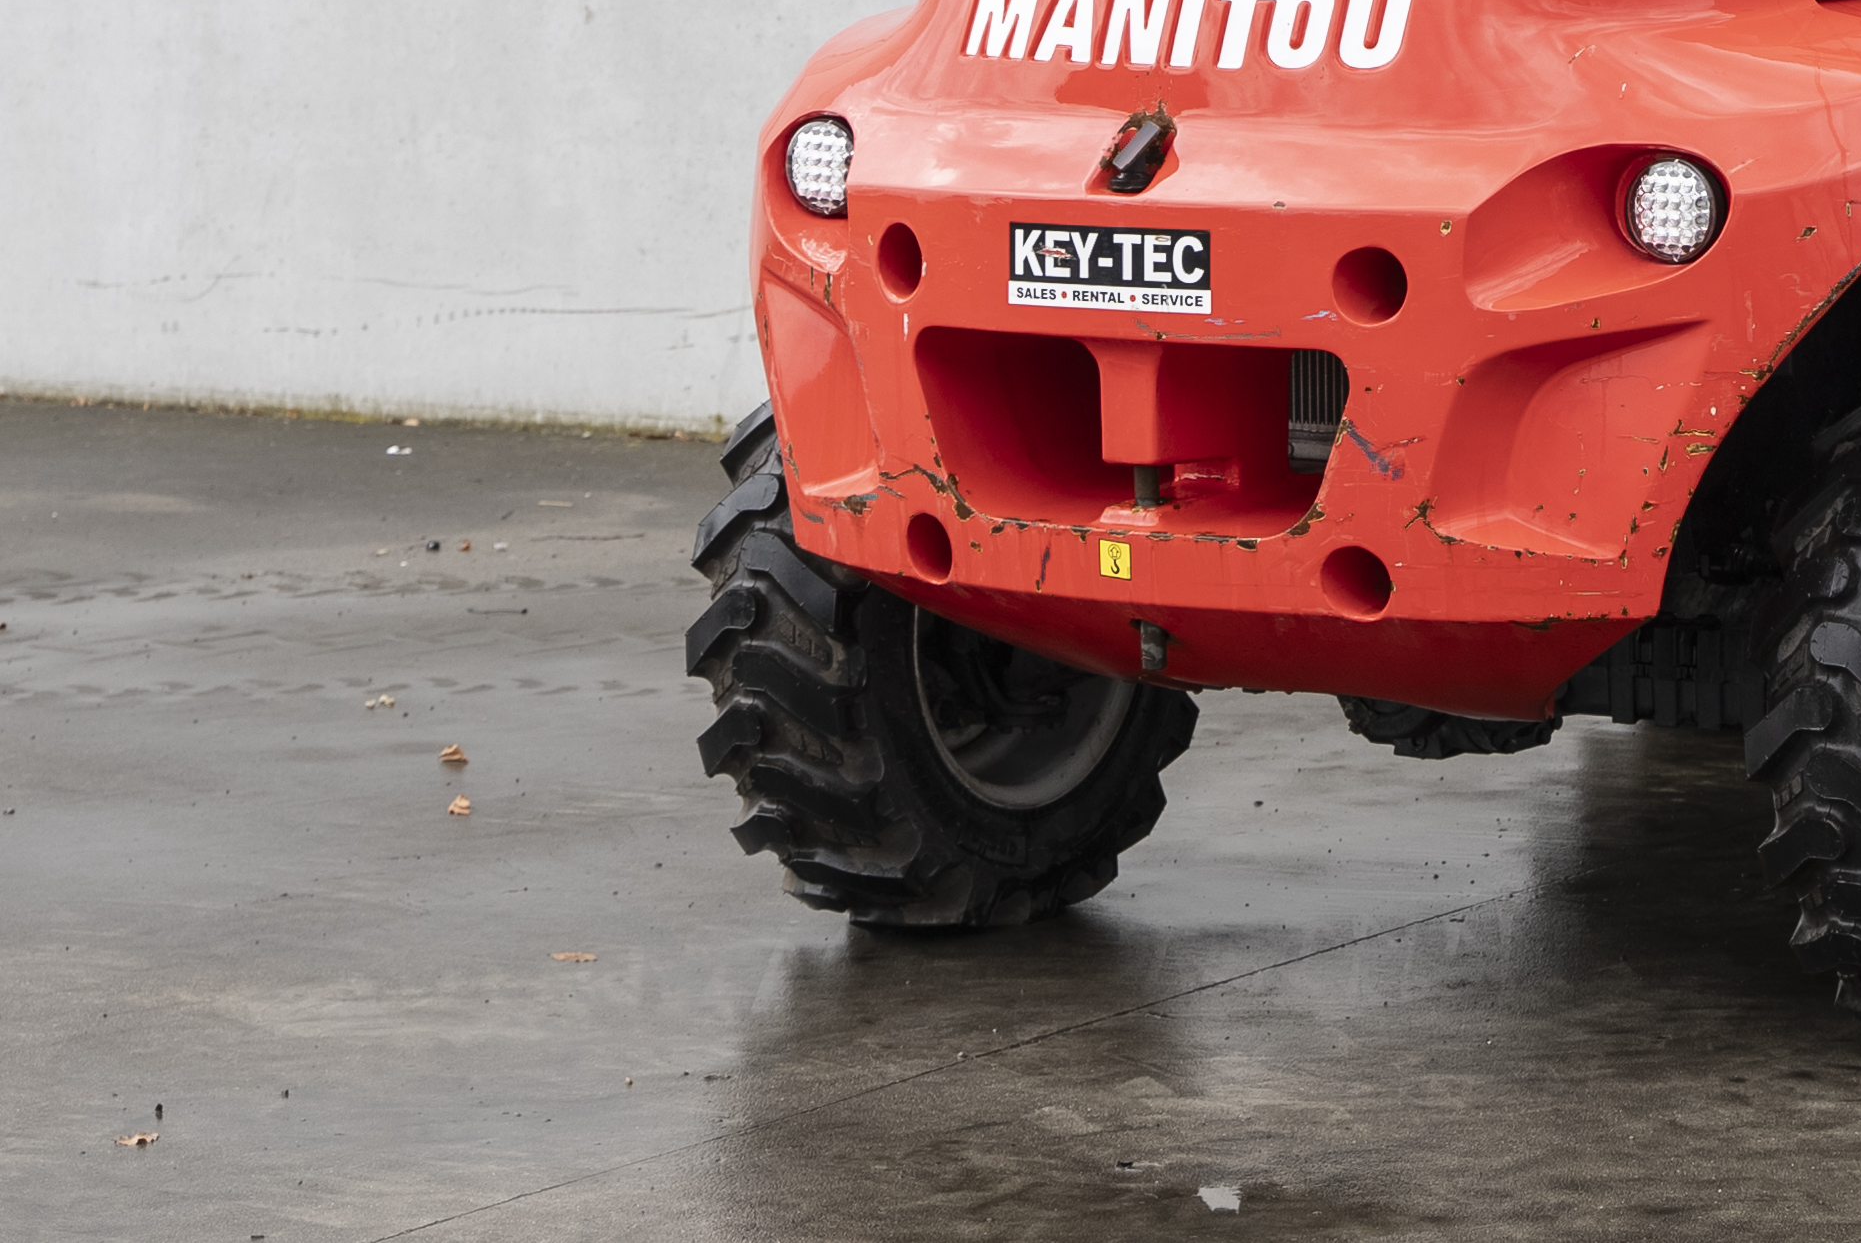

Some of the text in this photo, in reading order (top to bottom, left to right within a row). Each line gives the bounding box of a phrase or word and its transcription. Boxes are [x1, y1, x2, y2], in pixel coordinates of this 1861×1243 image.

[1015, 229, 1205, 283] KEY-TEC
[1016, 287, 1204, 307] SALES RENTAL SERVICE
